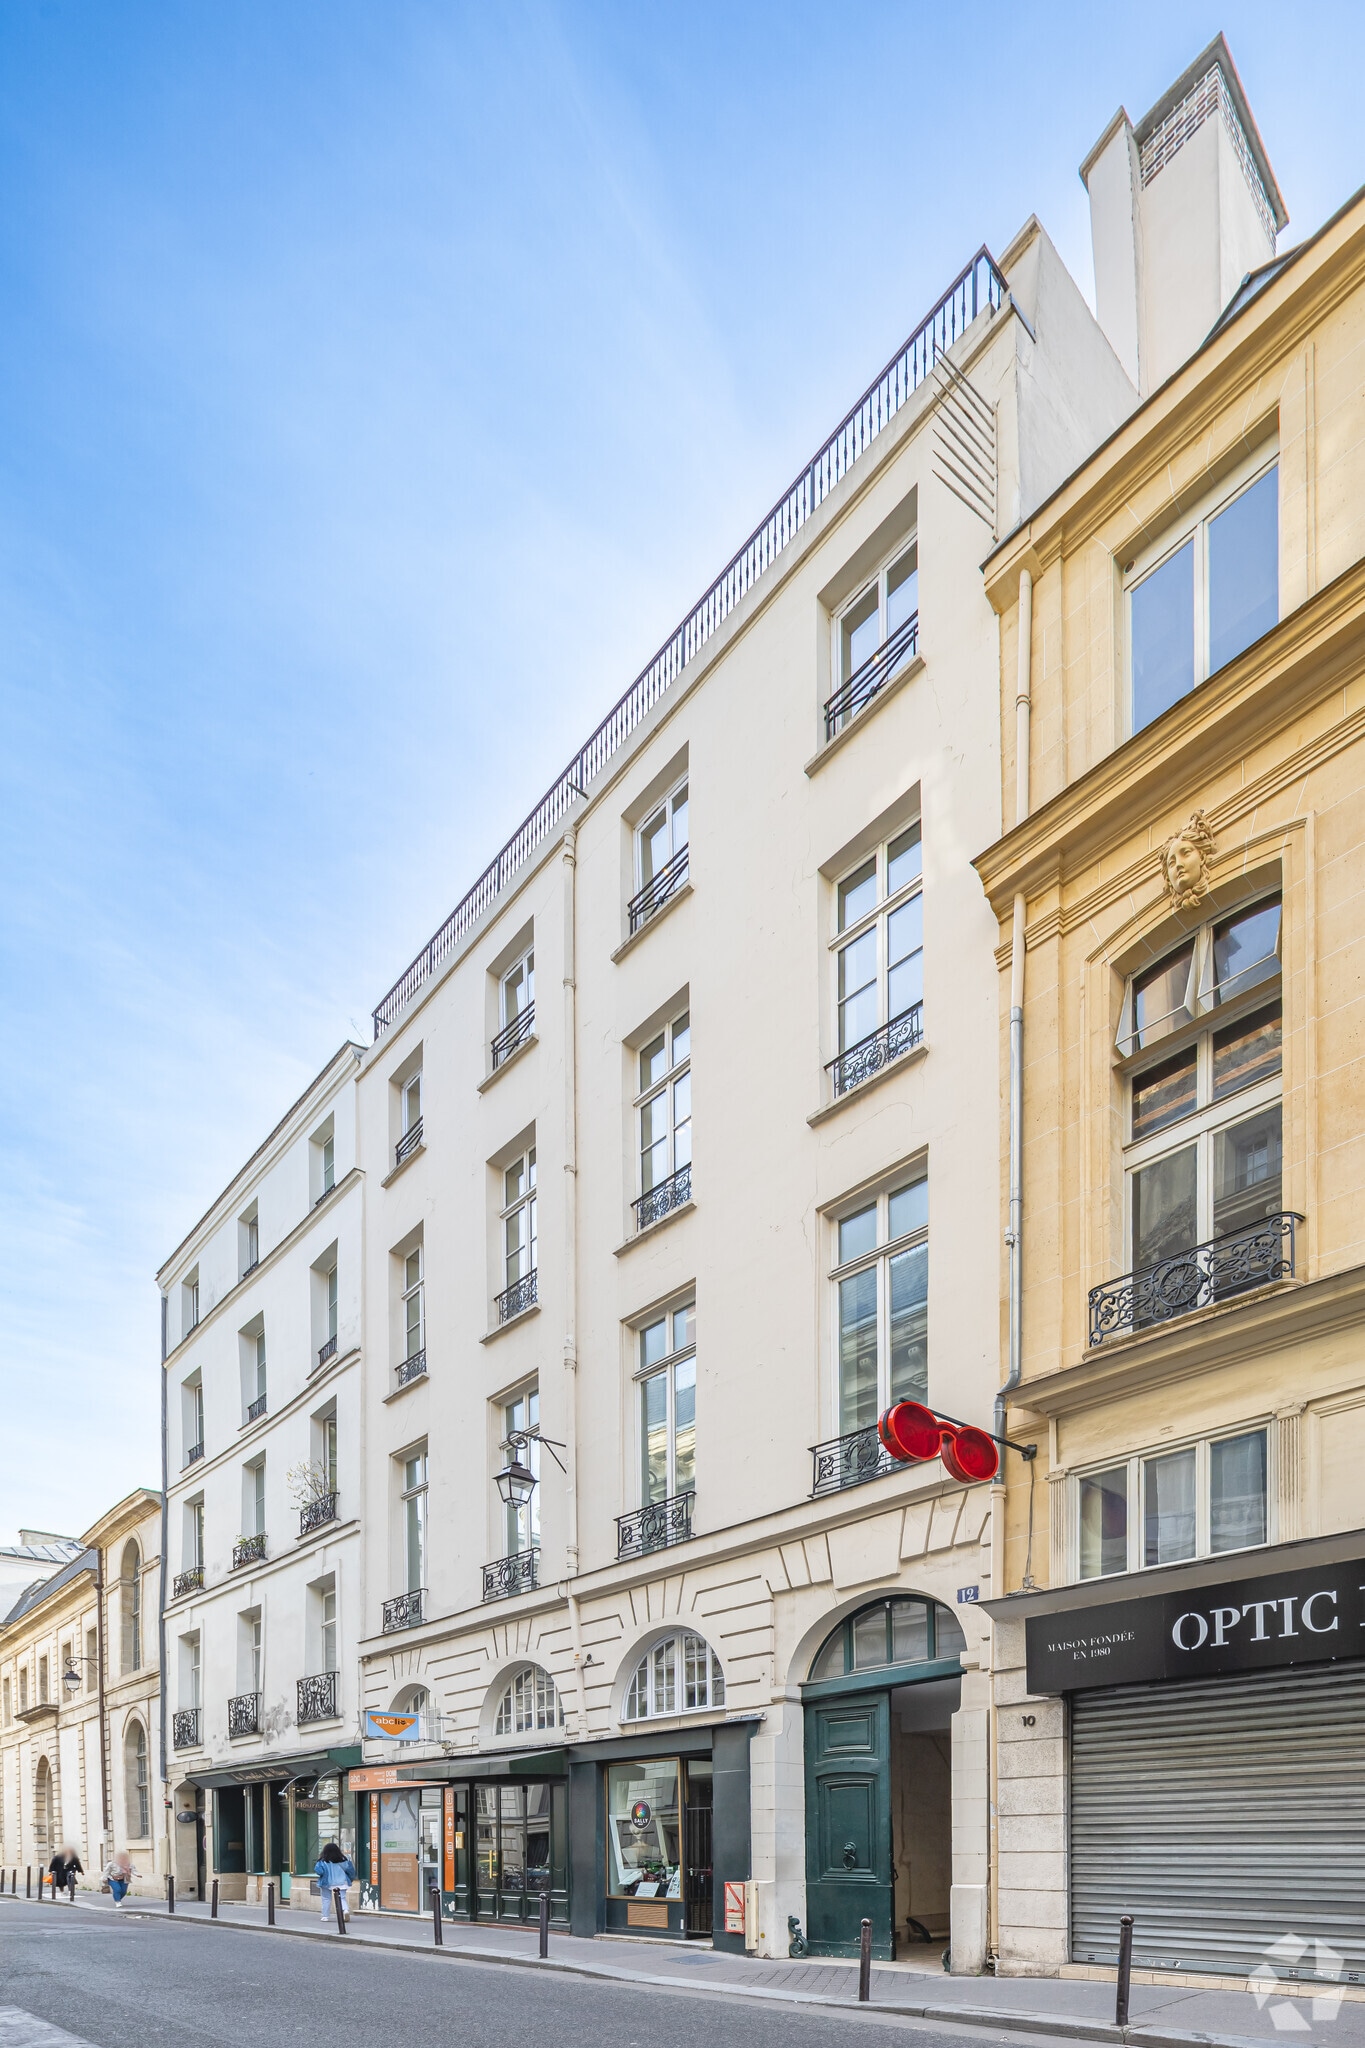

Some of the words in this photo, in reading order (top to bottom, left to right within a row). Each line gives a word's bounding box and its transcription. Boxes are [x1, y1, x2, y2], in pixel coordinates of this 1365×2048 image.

[961, 1587, 975, 1603] 12
[1171, 1590, 1339, 1651] OPTIC
[1047, 1639, 1088, 1653] MAISON
[1090, 1630, 1136, 1647] FONDÉE
[1073, 1650, 1087, 1660] EN
[1089, 1646, 1112, 1658] 1980
[1021, 1715, 1036, 1727] 10
